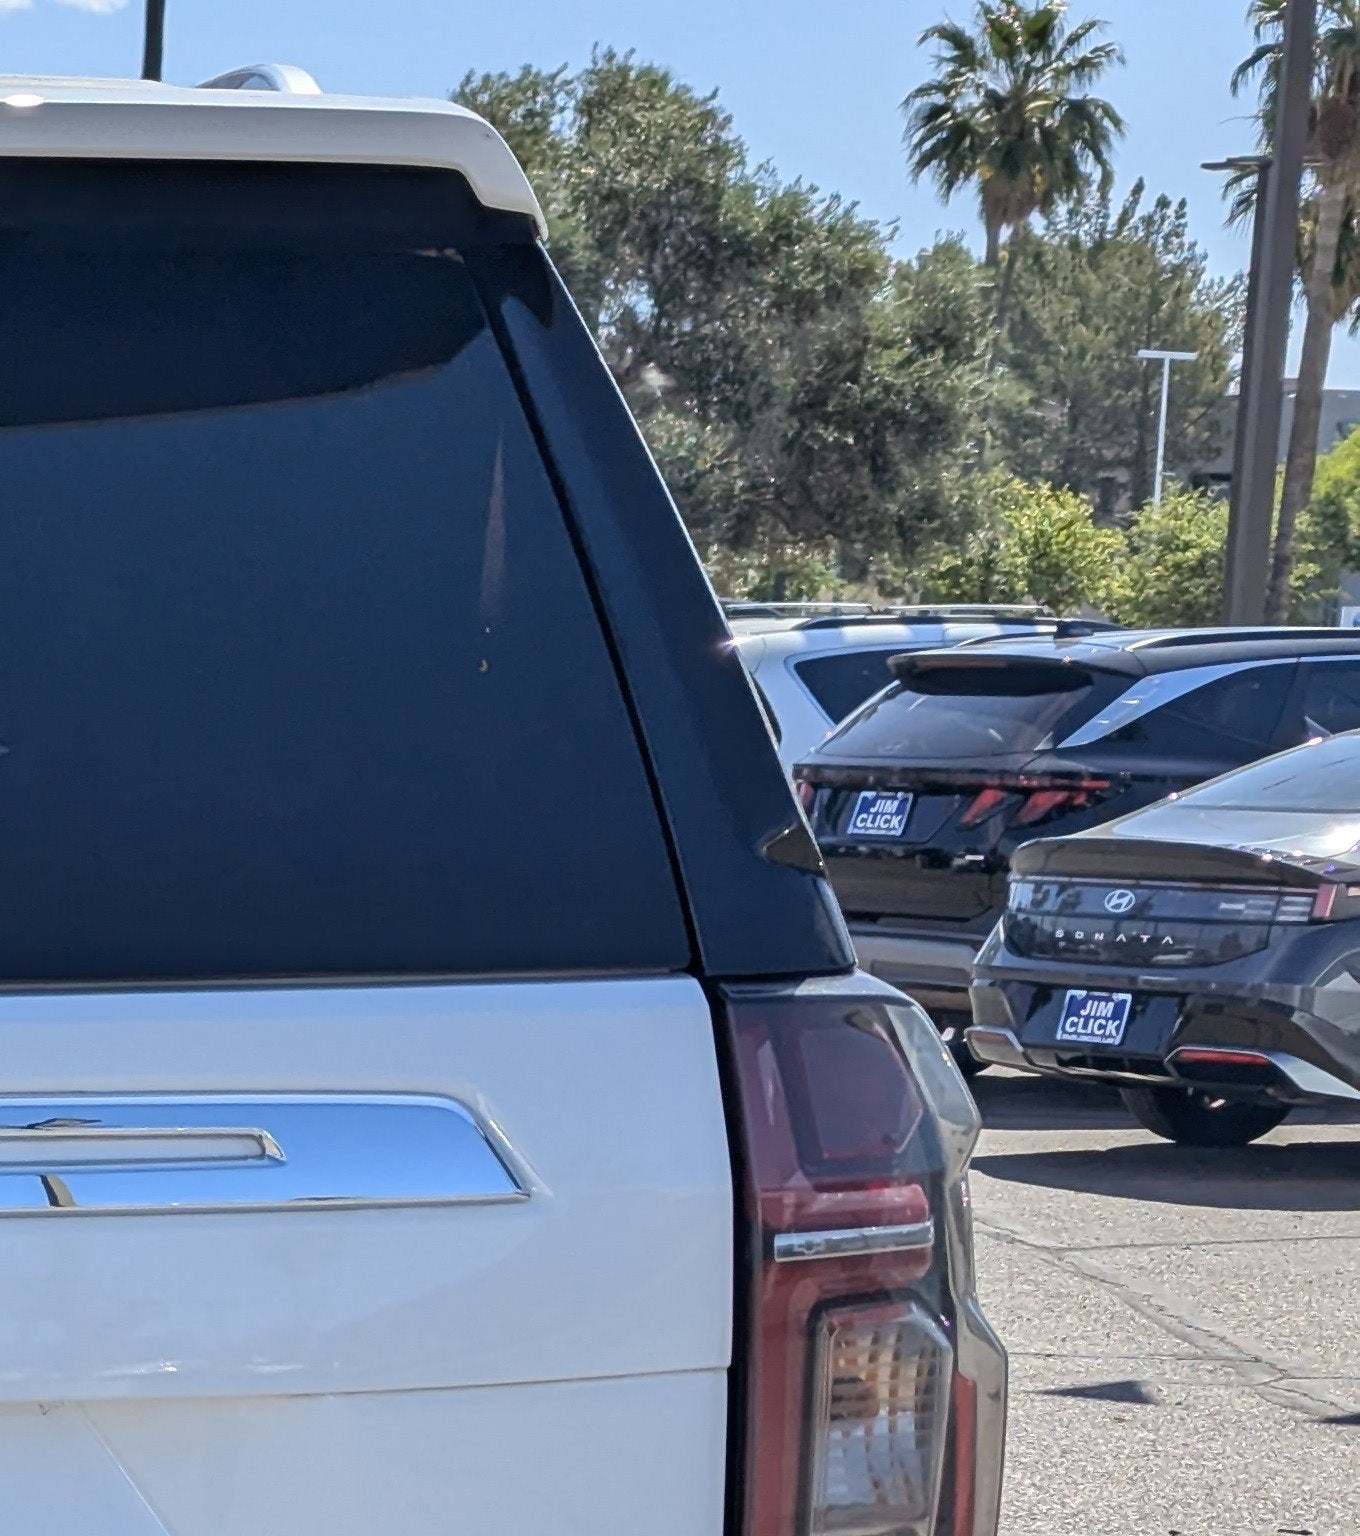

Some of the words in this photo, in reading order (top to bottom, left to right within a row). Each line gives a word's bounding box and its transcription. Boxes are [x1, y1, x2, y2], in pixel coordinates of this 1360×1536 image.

[870, 799, 899, 813] JIM
[856, 813, 902, 829] CLICK
[1055, 929, 1174, 945] SONATA
[1080, 1000, 1115, 1017] JIM
[1065, 1016, 1120, 1037] CLICK
